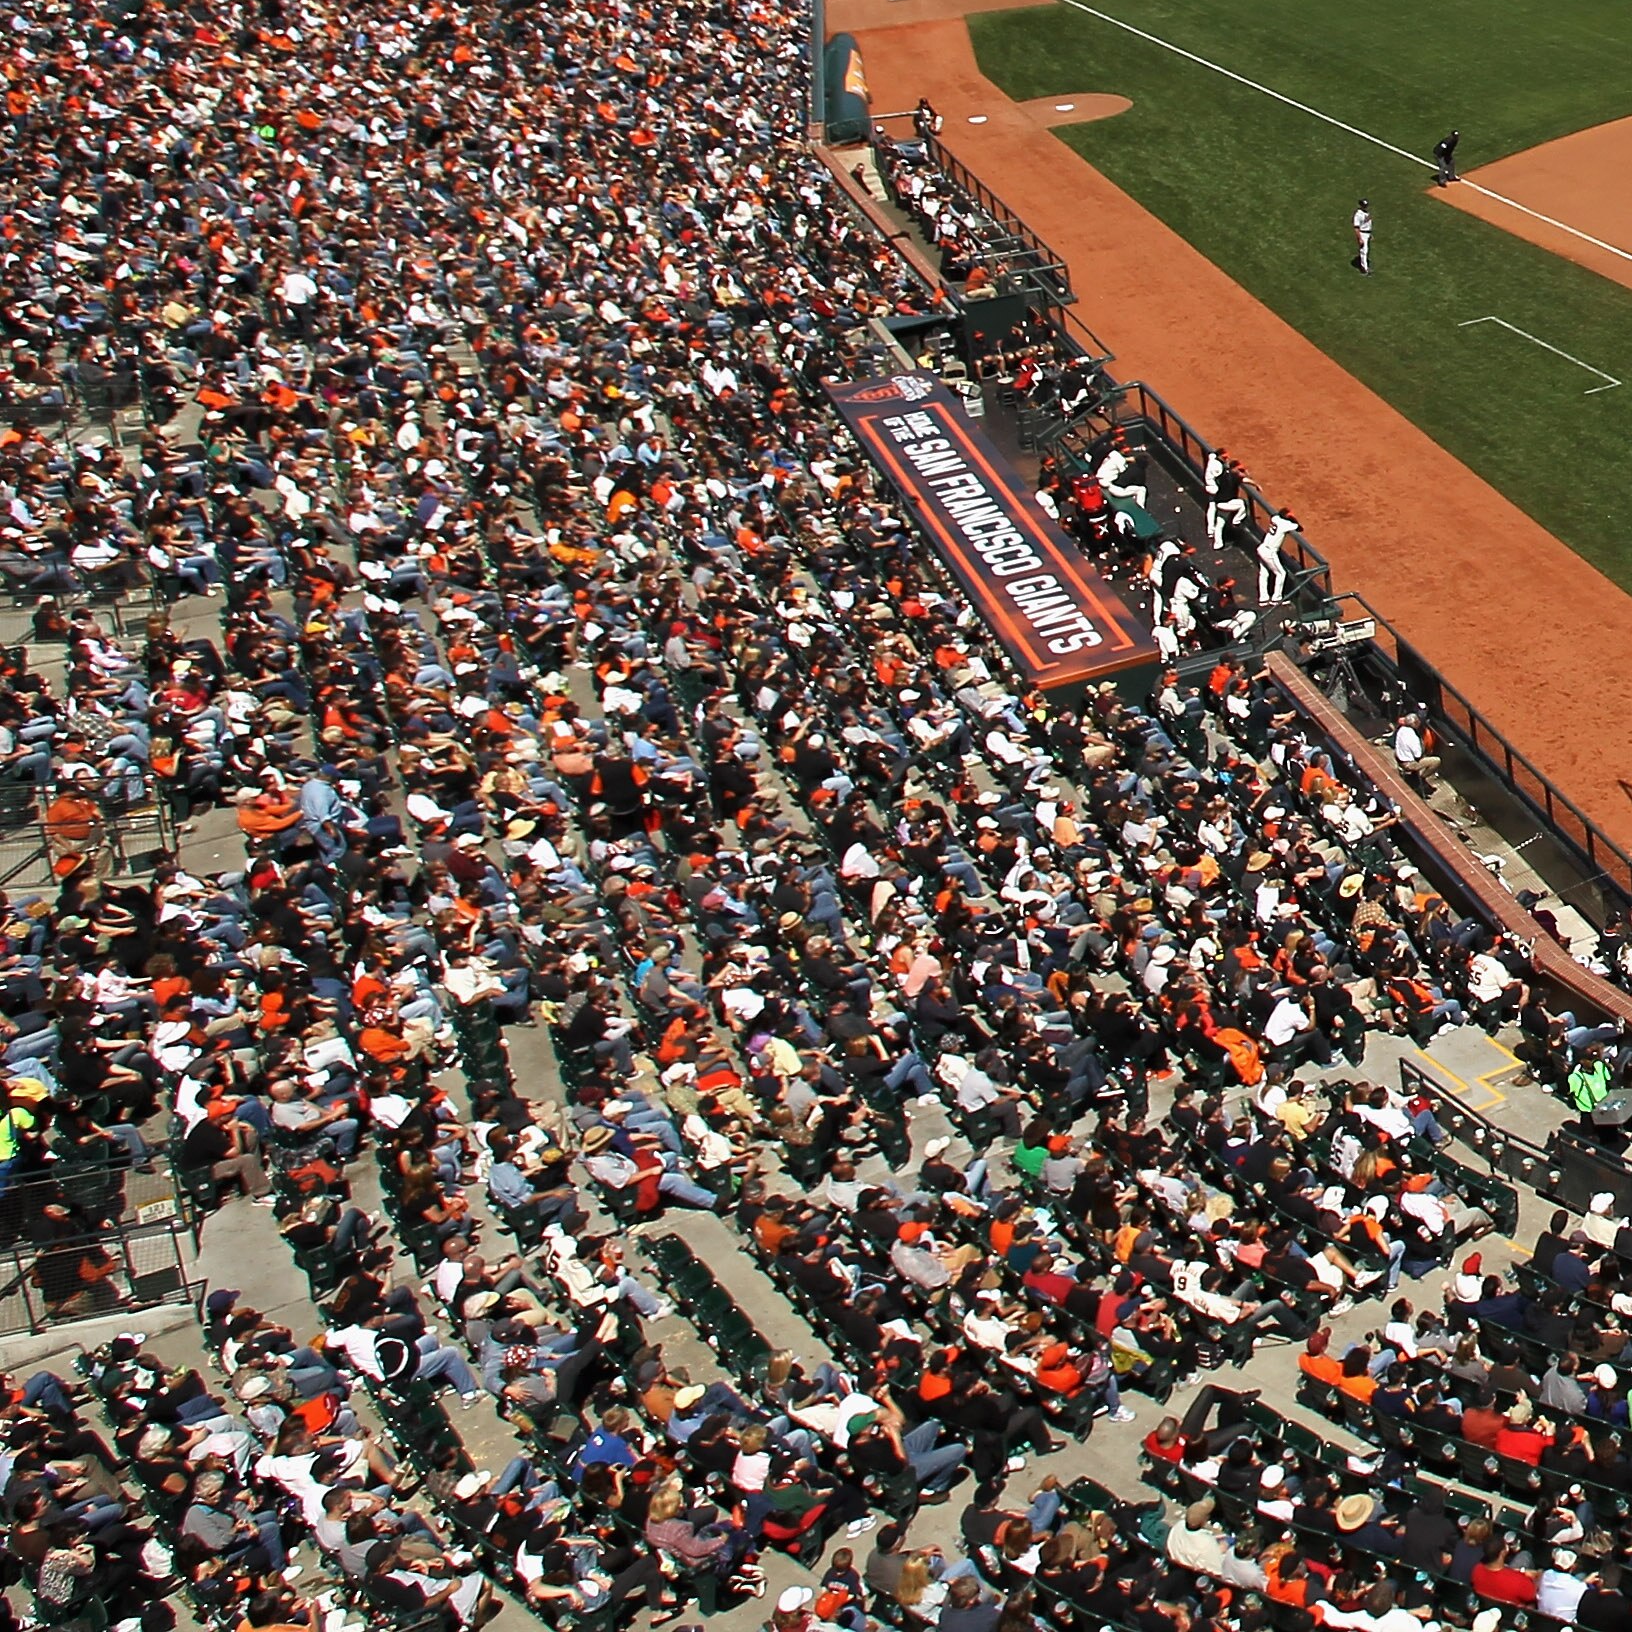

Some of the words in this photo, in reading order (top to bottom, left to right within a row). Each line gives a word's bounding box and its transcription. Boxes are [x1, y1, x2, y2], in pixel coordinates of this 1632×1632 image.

[903, 438, 968, 477] SAN
[928, 472, 1043, 578] FRANCISCO
[1005, 574, 1103, 655] GIANTS
[1178, 1275, 1187, 1292] 9
